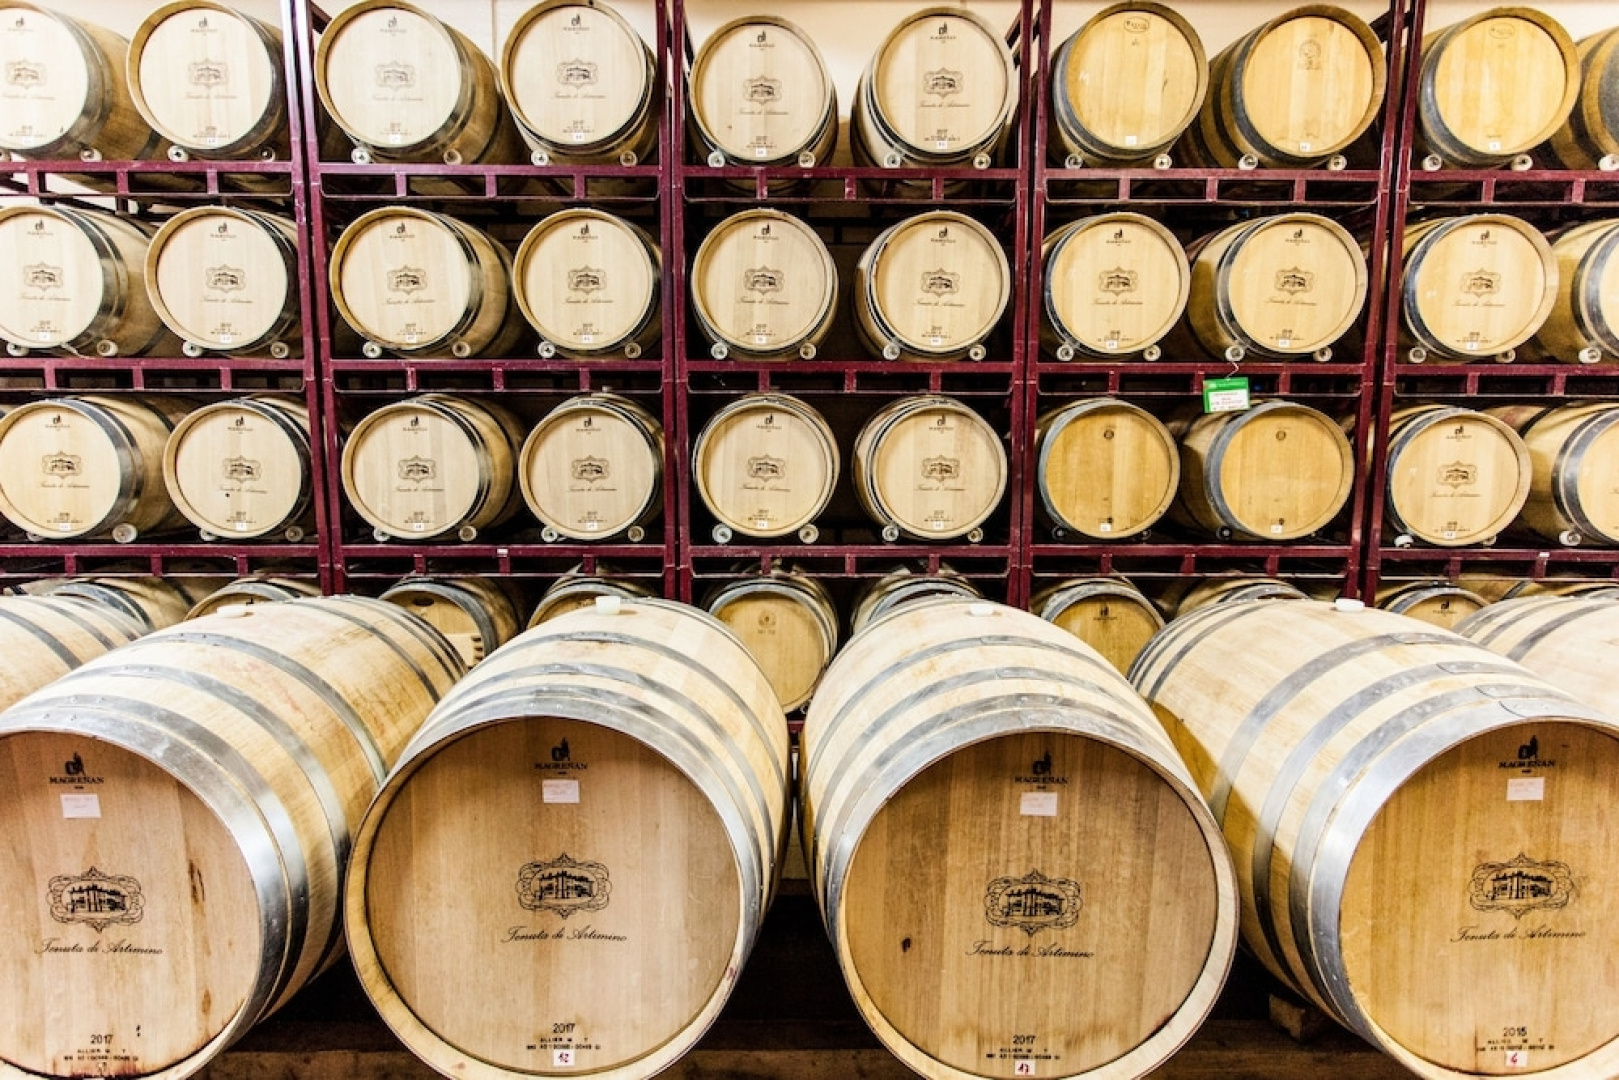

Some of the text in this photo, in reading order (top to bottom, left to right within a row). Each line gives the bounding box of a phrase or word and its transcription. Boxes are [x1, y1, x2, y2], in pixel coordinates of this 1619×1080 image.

[500, 926, 549, 943] Tenuta
[553, 1022, 575, 1033] 2017
[90, 1034, 114, 1046] 2017
[1013, 1034, 1036, 1045] 2017
